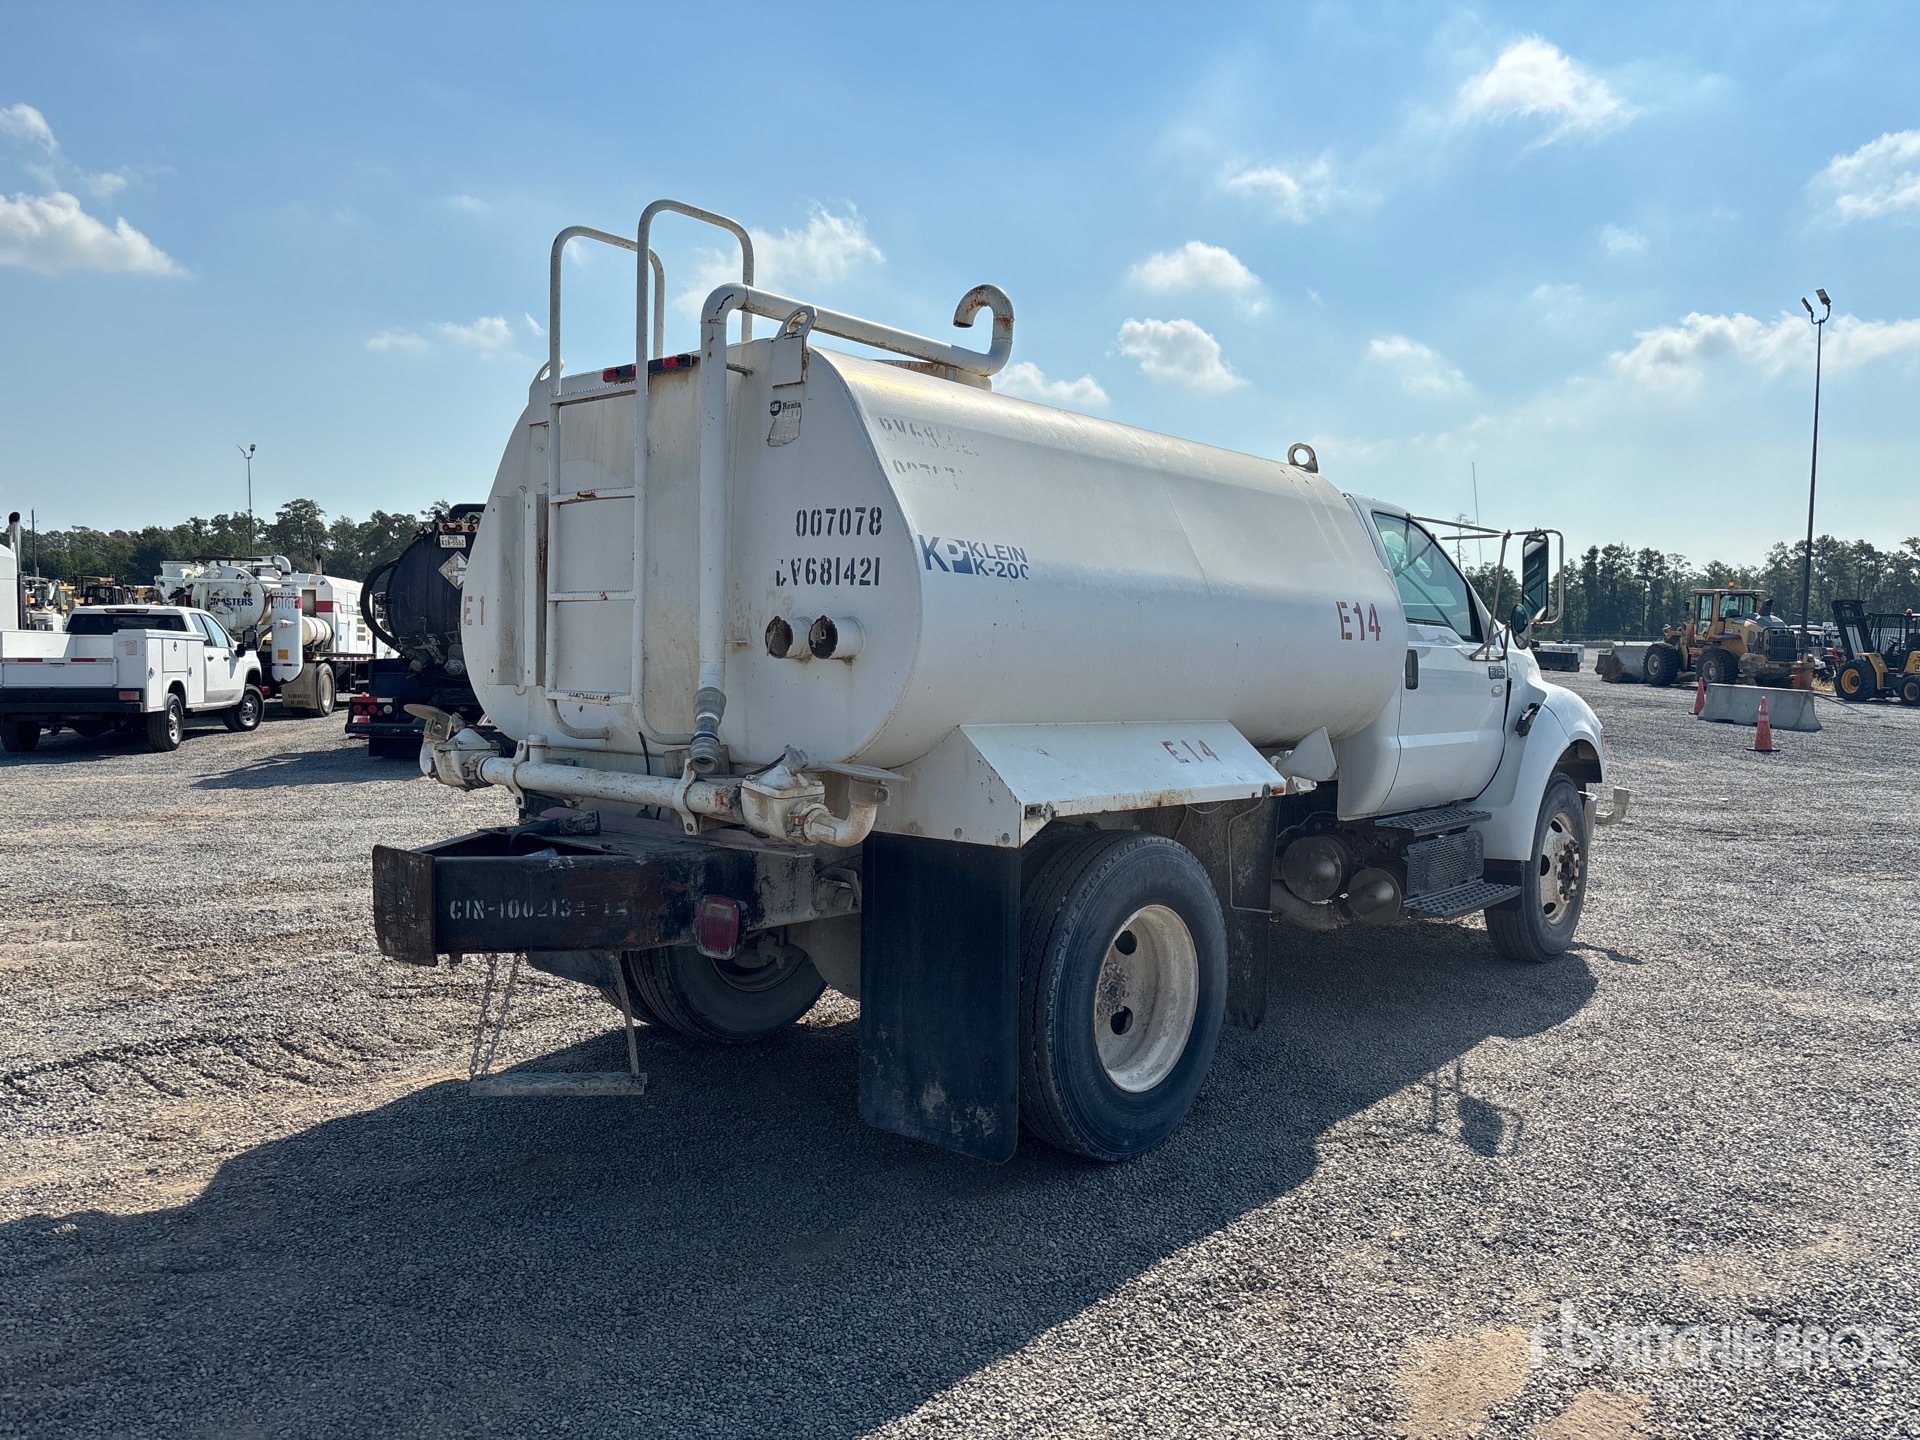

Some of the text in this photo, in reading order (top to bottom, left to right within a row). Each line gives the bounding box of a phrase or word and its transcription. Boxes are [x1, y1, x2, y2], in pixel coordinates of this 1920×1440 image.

[795, 506, 883, 537] 007078
[966, 540, 1028, 563] KLEIN
[1335, 600, 1382, 642] E14
[1160, 739, 1223, 765] E14
